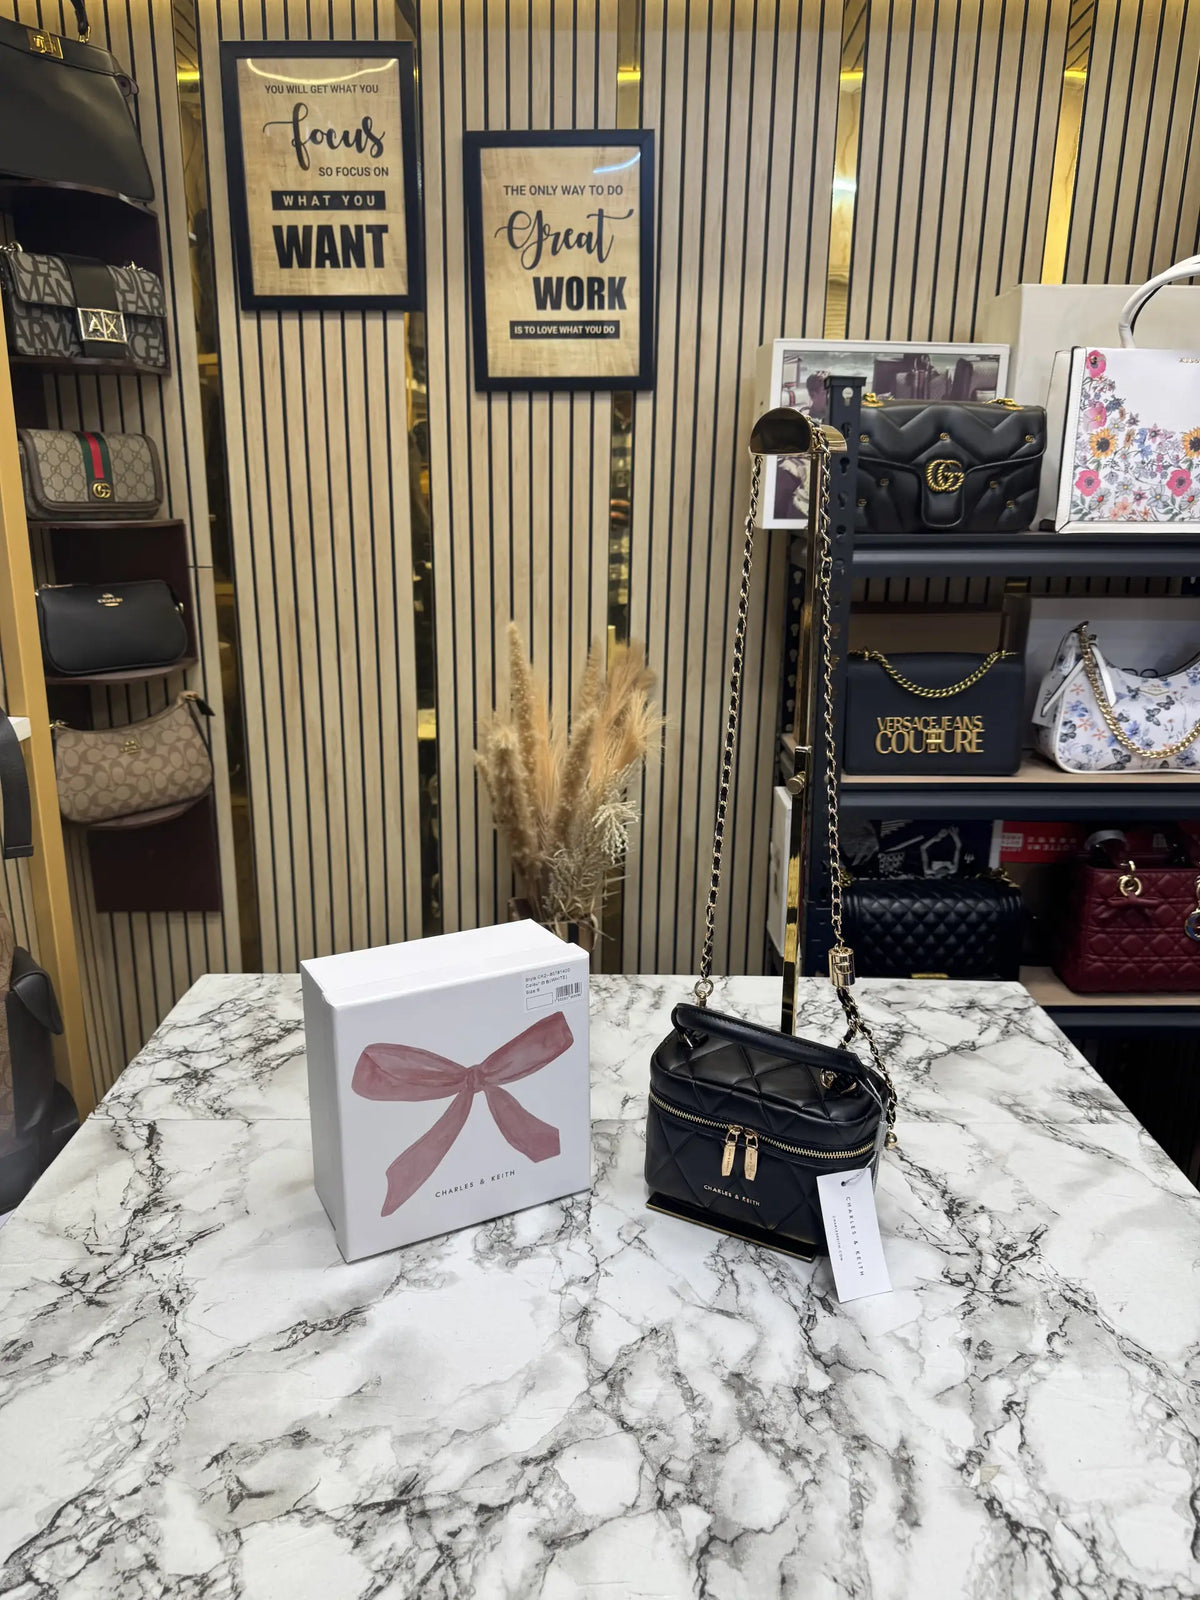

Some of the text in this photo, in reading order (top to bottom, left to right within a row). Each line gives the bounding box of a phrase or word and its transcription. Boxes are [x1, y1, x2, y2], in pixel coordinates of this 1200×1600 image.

[265, 84, 379, 94] YOU WILL GET WHAT YOU
[263, 102, 386, 171] focus
[318, 167, 389, 176] SO FOCUS ON
[282, 195, 375, 207] WHAT YOU
[503, 185, 623, 196] THE ONLY WAY TO DO
[272, 224, 388, 269] WANT
[494, 208, 634, 271] Great
[532, 276, 627, 311] WORK
[514, 325, 615, 334] IS TO LOVE WHAT YOU DO
[876, 715, 983, 732] VERSACE JEANS
[435, 1182, 474, 1198] CHARLES
[491, 1169, 515, 1182] KEITH
[703, 1184, 732, 1198] CHARLES
[742, 1196, 760, 1206] KEITH
[846, 1196, 857, 1236] CHARLES
[855, 1250, 864, 1276] KEITH
